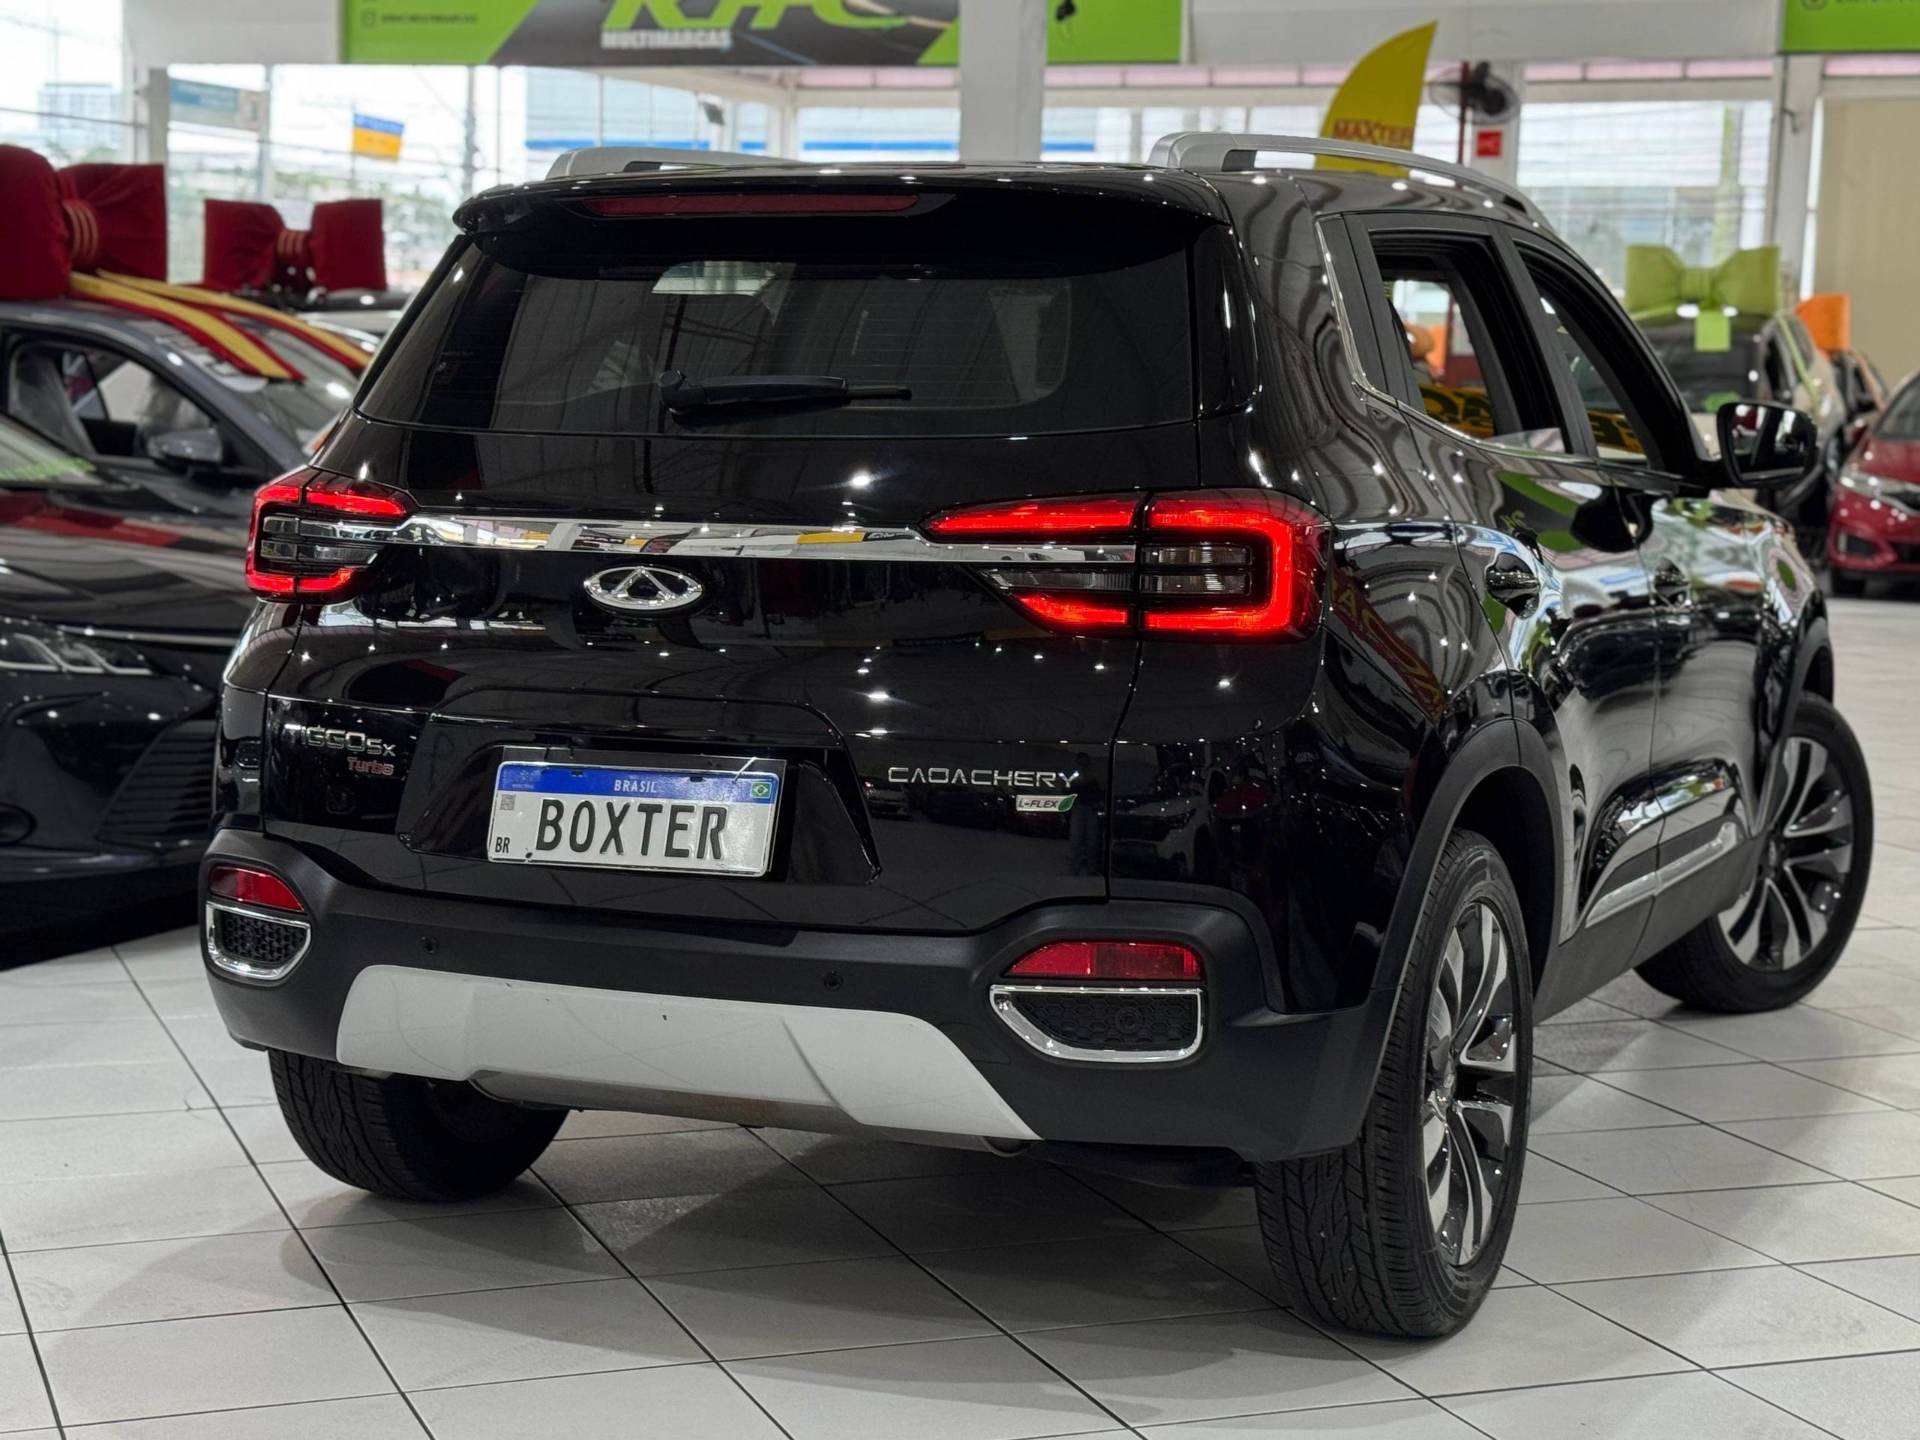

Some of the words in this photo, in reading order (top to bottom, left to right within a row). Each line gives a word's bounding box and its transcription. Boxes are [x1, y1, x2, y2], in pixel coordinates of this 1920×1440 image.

[347, 756, 395, 776] Turbo
[613, 779, 658, 794] BRASIL
[535, 798, 729, 860] BOXTER
[494, 836, 511, 854] BR
